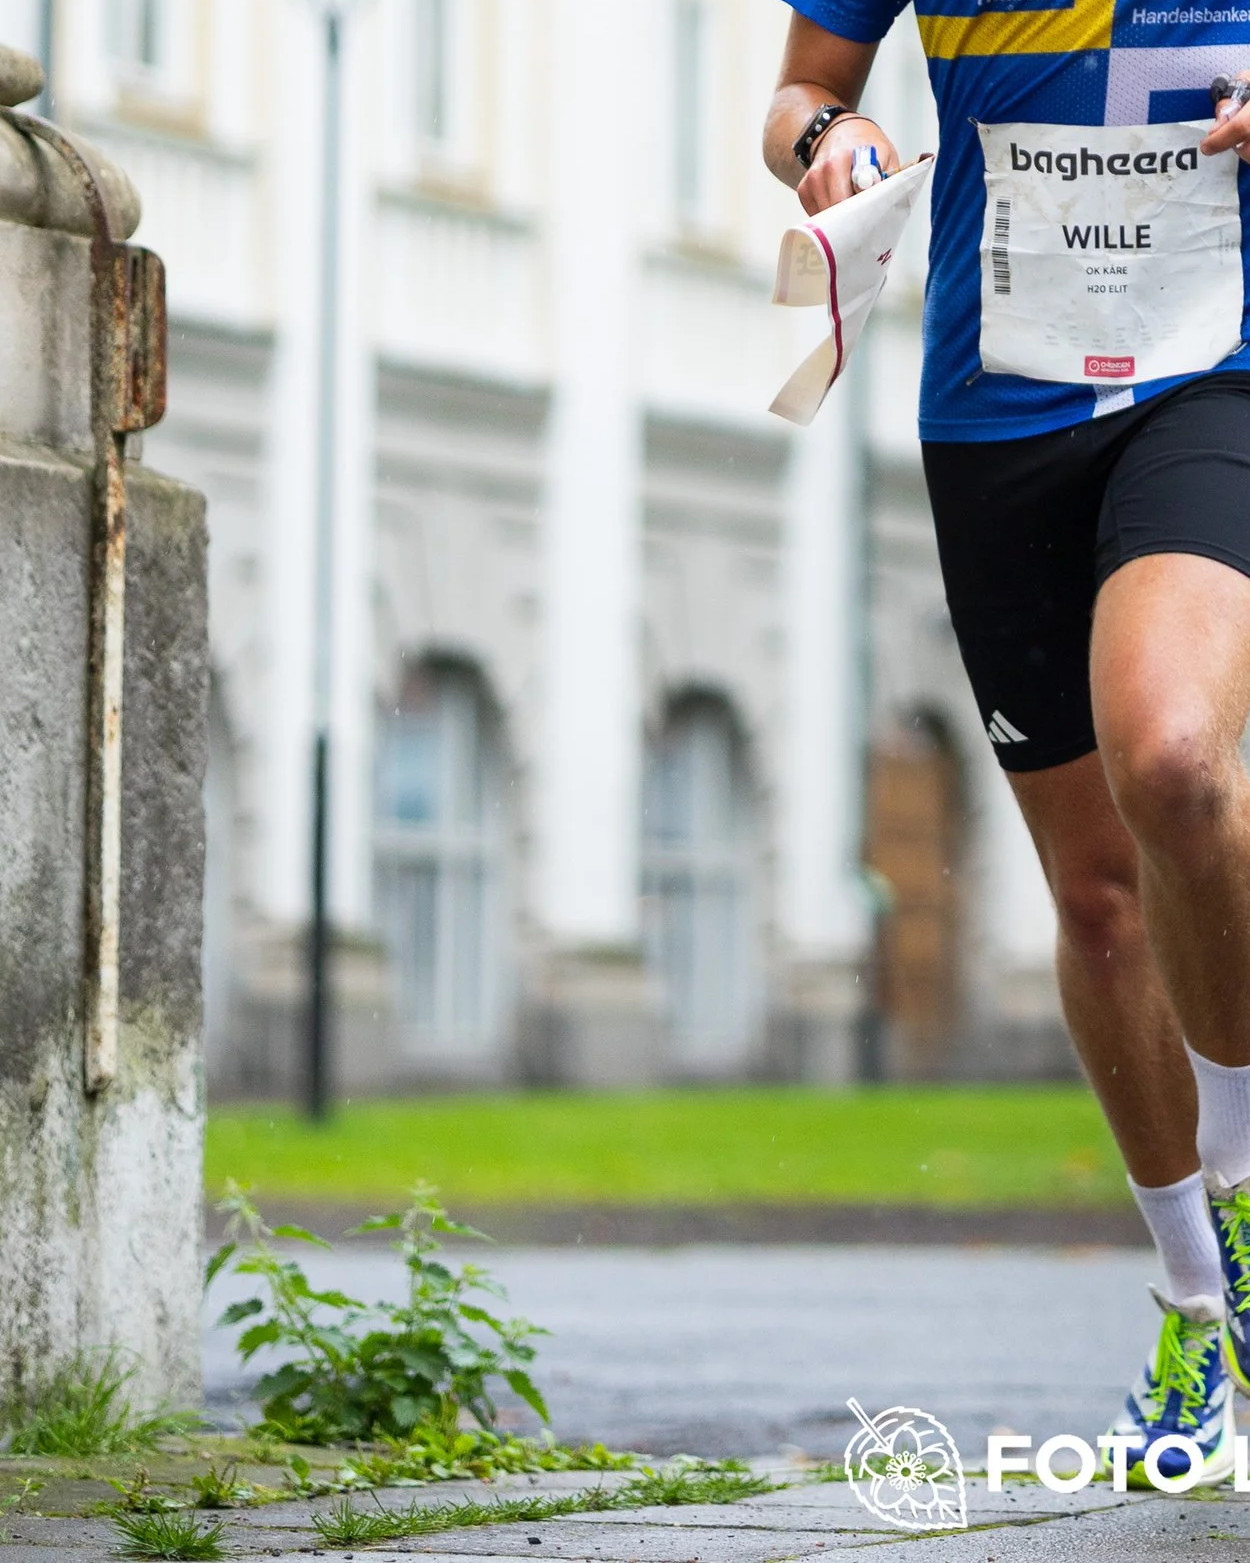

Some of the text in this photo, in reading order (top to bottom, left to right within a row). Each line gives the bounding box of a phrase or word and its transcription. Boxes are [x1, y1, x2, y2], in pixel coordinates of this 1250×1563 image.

[1010, 142, 1199, 181] bagheera
[1062, 224, 1152, 250] WILLE
[1086, 266, 1100, 275] OK
[1109, 284, 1128, 293] ELIT
